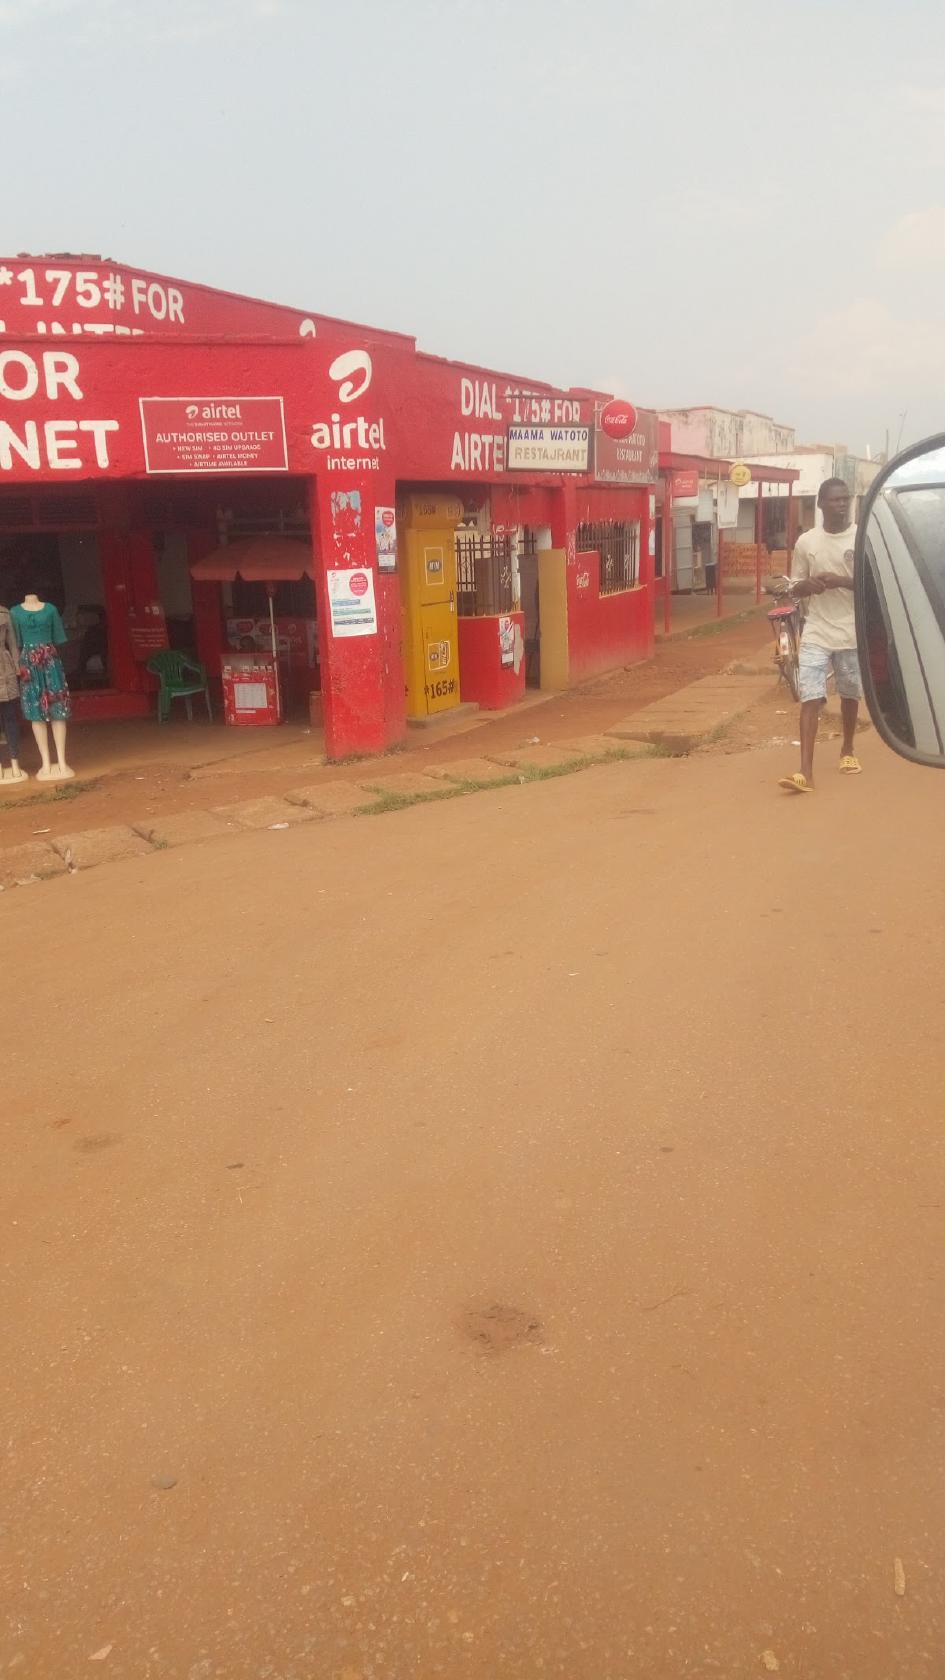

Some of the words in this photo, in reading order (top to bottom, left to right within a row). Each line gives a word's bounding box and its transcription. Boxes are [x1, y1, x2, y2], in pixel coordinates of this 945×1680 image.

[131, 278, 186, 325] FOR
[461, 377, 503, 421] DIAL
[554, 399, 581, 423] FOR
[202, 402, 242, 419] airtel
[156, 431, 228, 443] AUTHORISED
[231, 431, 275, 442] OUTLET
[310, 413, 386, 451] airtel
[509, 428, 544, 441] MAAMA
[550, 429, 588, 442] WATOTO
[326, 454, 379, 471] internet
